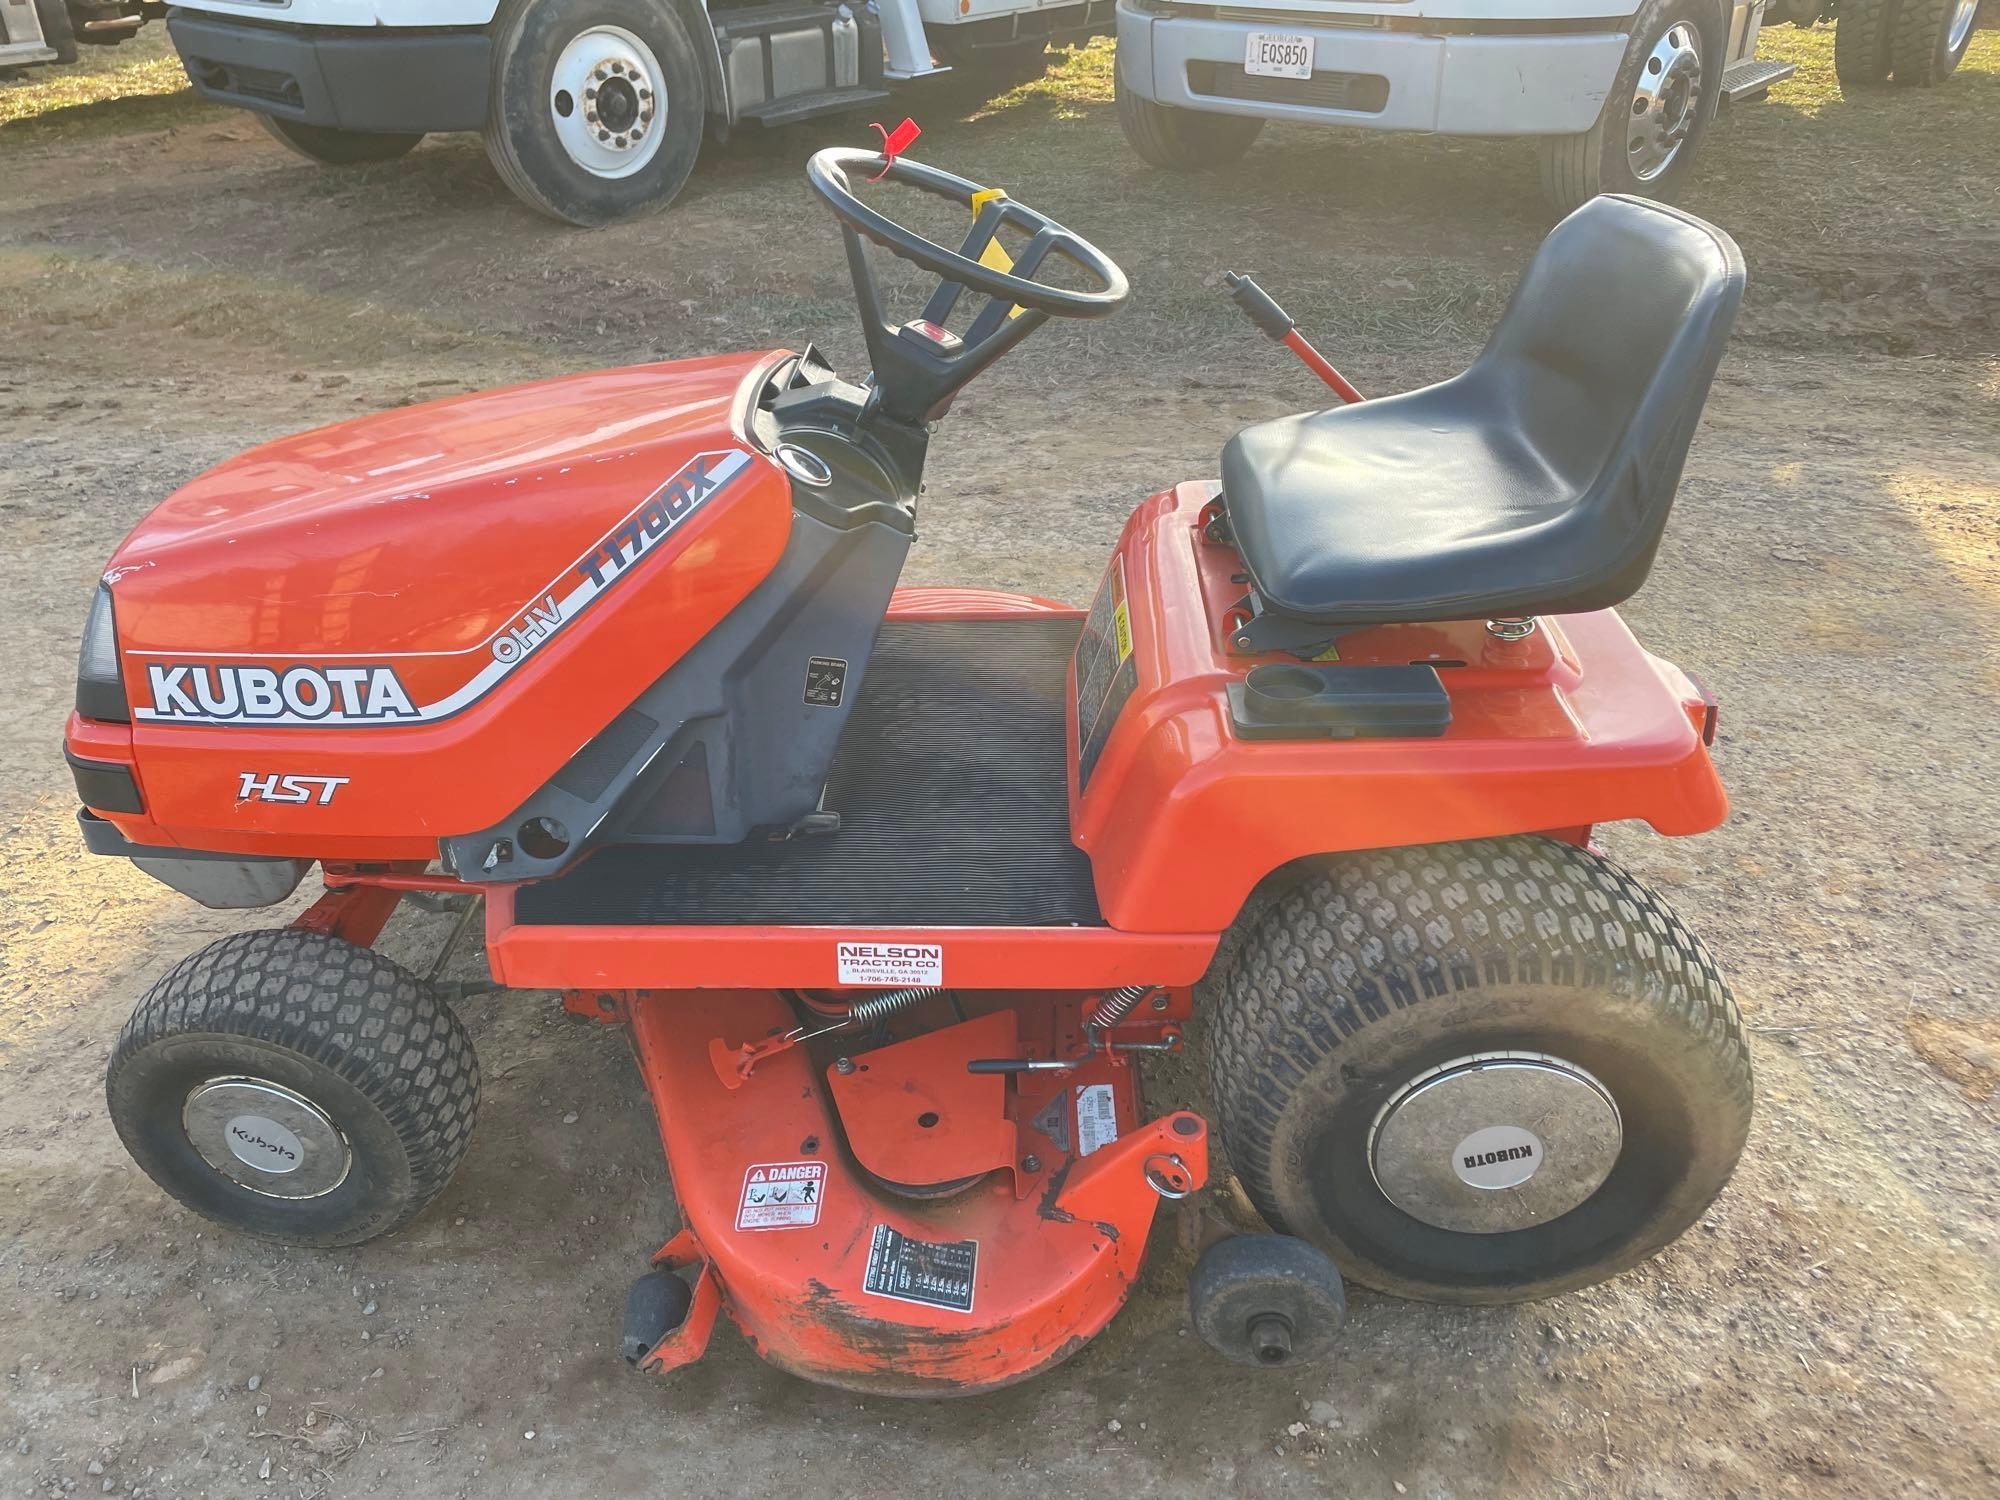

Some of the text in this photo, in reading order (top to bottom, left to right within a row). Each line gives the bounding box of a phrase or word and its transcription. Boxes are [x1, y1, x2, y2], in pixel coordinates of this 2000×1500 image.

[1261, 43, 1307, 66] EQS850
[491, 458, 717, 664] OHV T1700X
[147, 663, 421, 719] KUBOTA
[239, 772, 350, 805] HST
[840, 946, 939, 959] NELSON
[840, 959, 939, 968] TRACTOR CO.
[232, 1126, 295, 1161] Kubota
[1463, 1145, 1533, 1168] KUBOTA
[769, 1165, 821, 1181] DANGER
[867, 1266, 877, 1288] CUTTING
